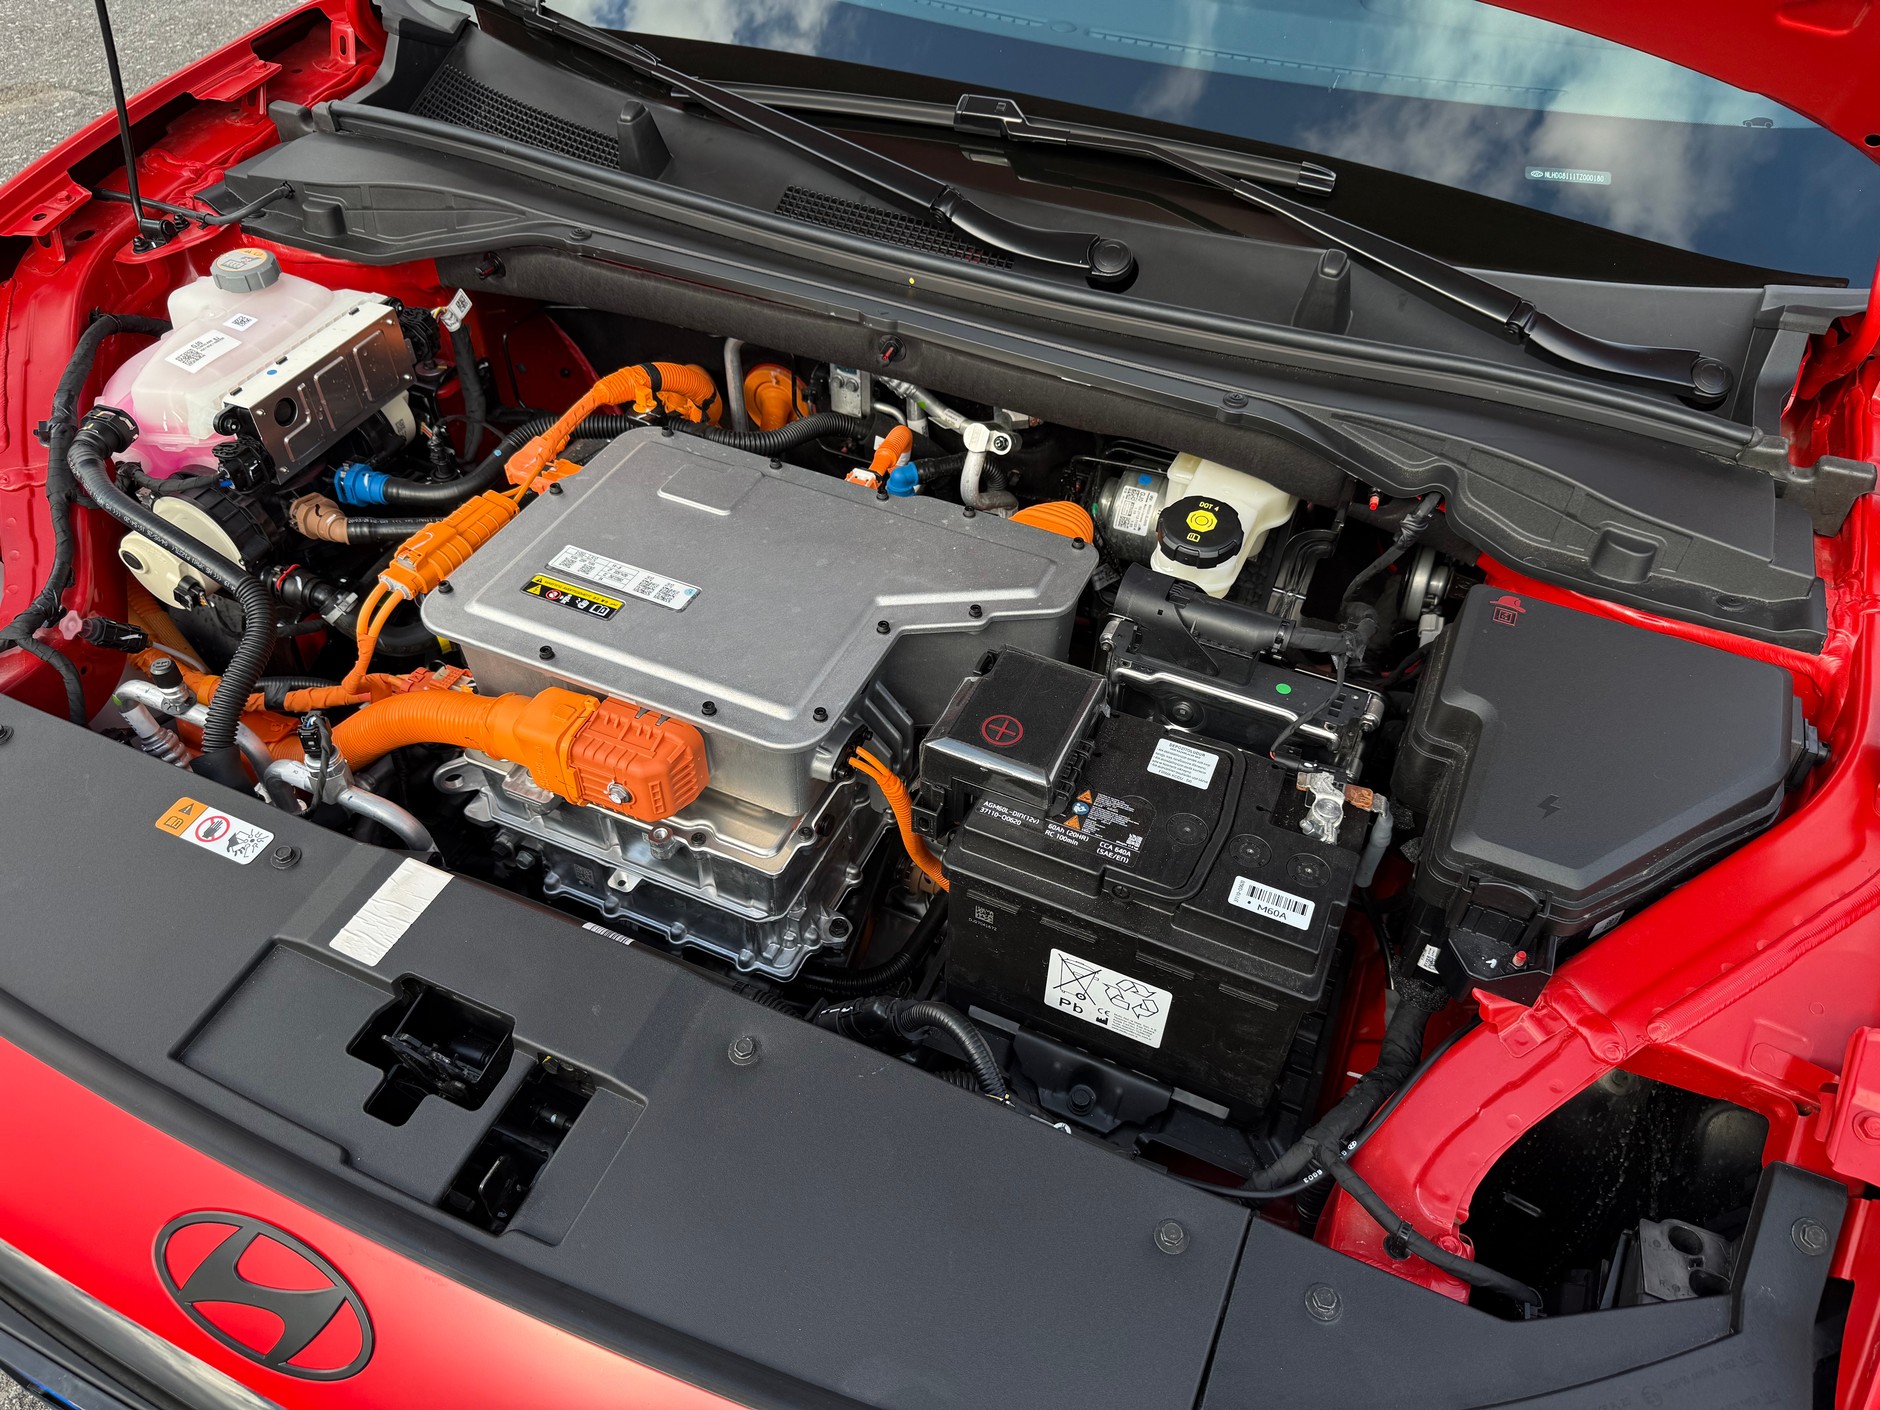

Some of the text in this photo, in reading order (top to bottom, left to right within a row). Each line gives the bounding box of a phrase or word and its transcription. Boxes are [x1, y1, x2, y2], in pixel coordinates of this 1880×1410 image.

[1199, 501, 1213, 510] DOT
[1045, 830, 1078, 846] RC 100min
[1048, 823, 1089, 842] 60Ah (20HR)
[1099, 841, 1112, 851] CCA
[1114, 846, 1131, 857] 640A
[1257, 904, 1287, 920] M60A
[1059, 998, 1084, 1014] Pb
